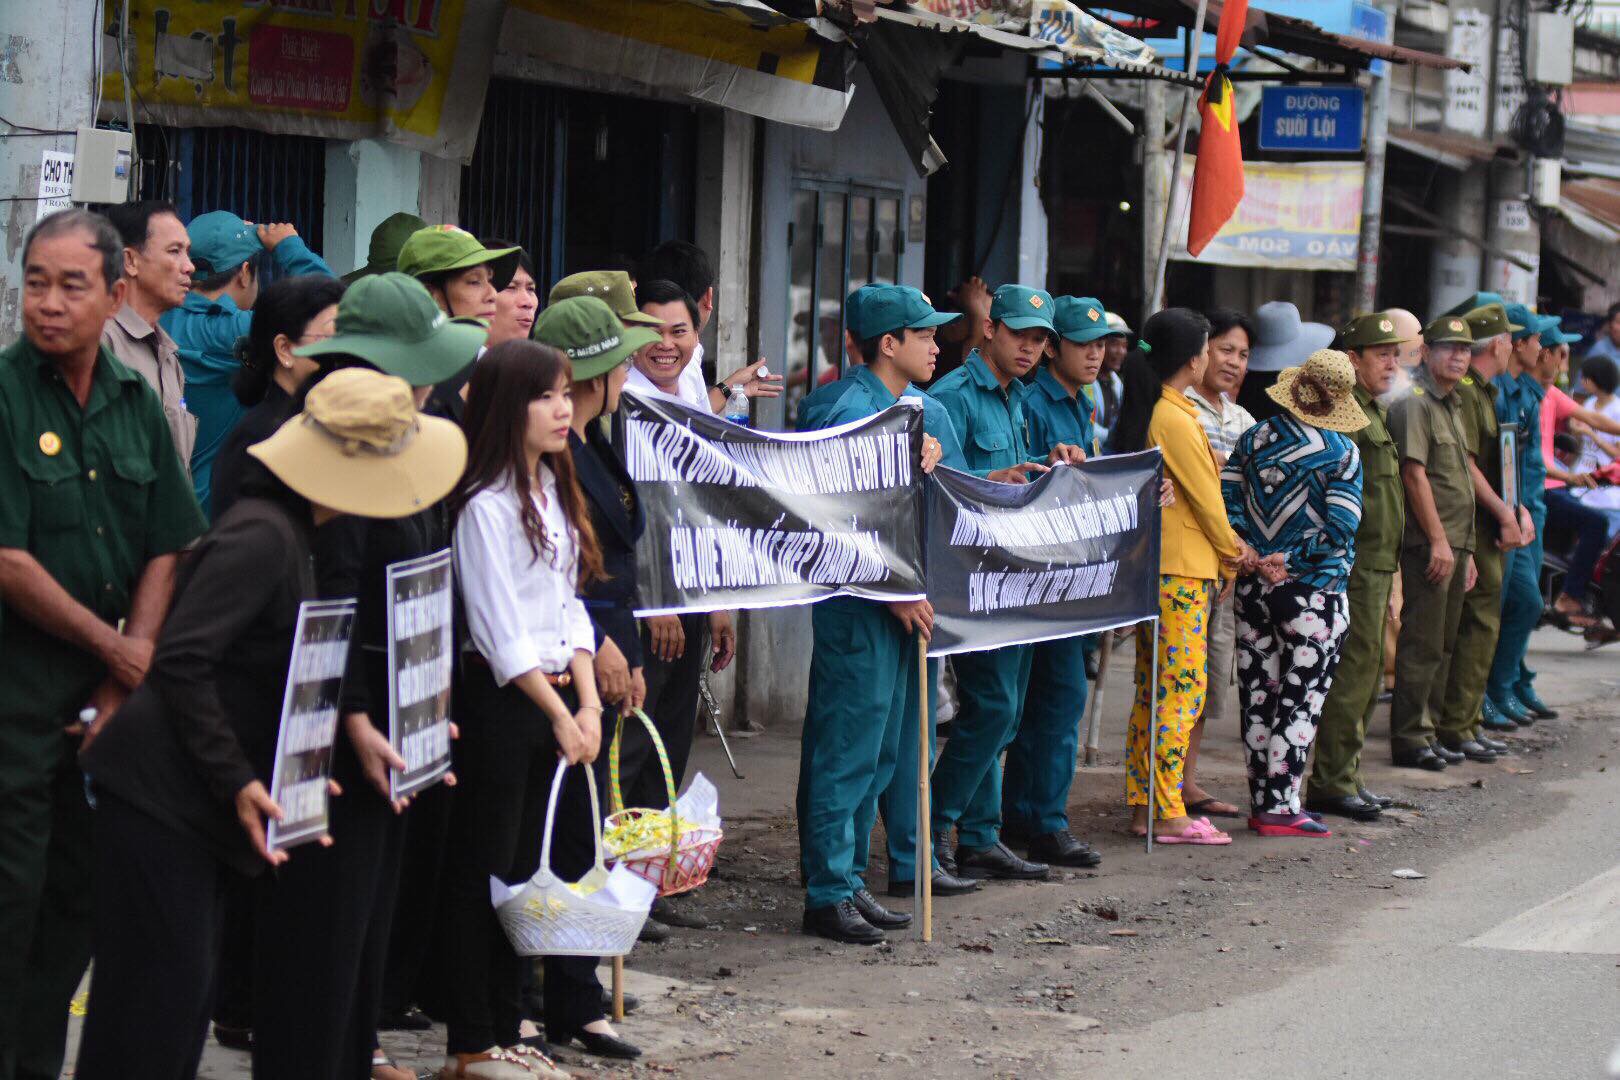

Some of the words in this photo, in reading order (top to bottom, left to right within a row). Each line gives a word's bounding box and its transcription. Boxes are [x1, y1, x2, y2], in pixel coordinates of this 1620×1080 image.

[44, 159, 61, 182] CHO
[63, 161, 75, 183] TH
[847, 436, 879, 492] CON
[896, 420, 911, 487] TÚ
[671, 508, 698, 590] CỦA
[695, 515, 720, 595] QUÊ
